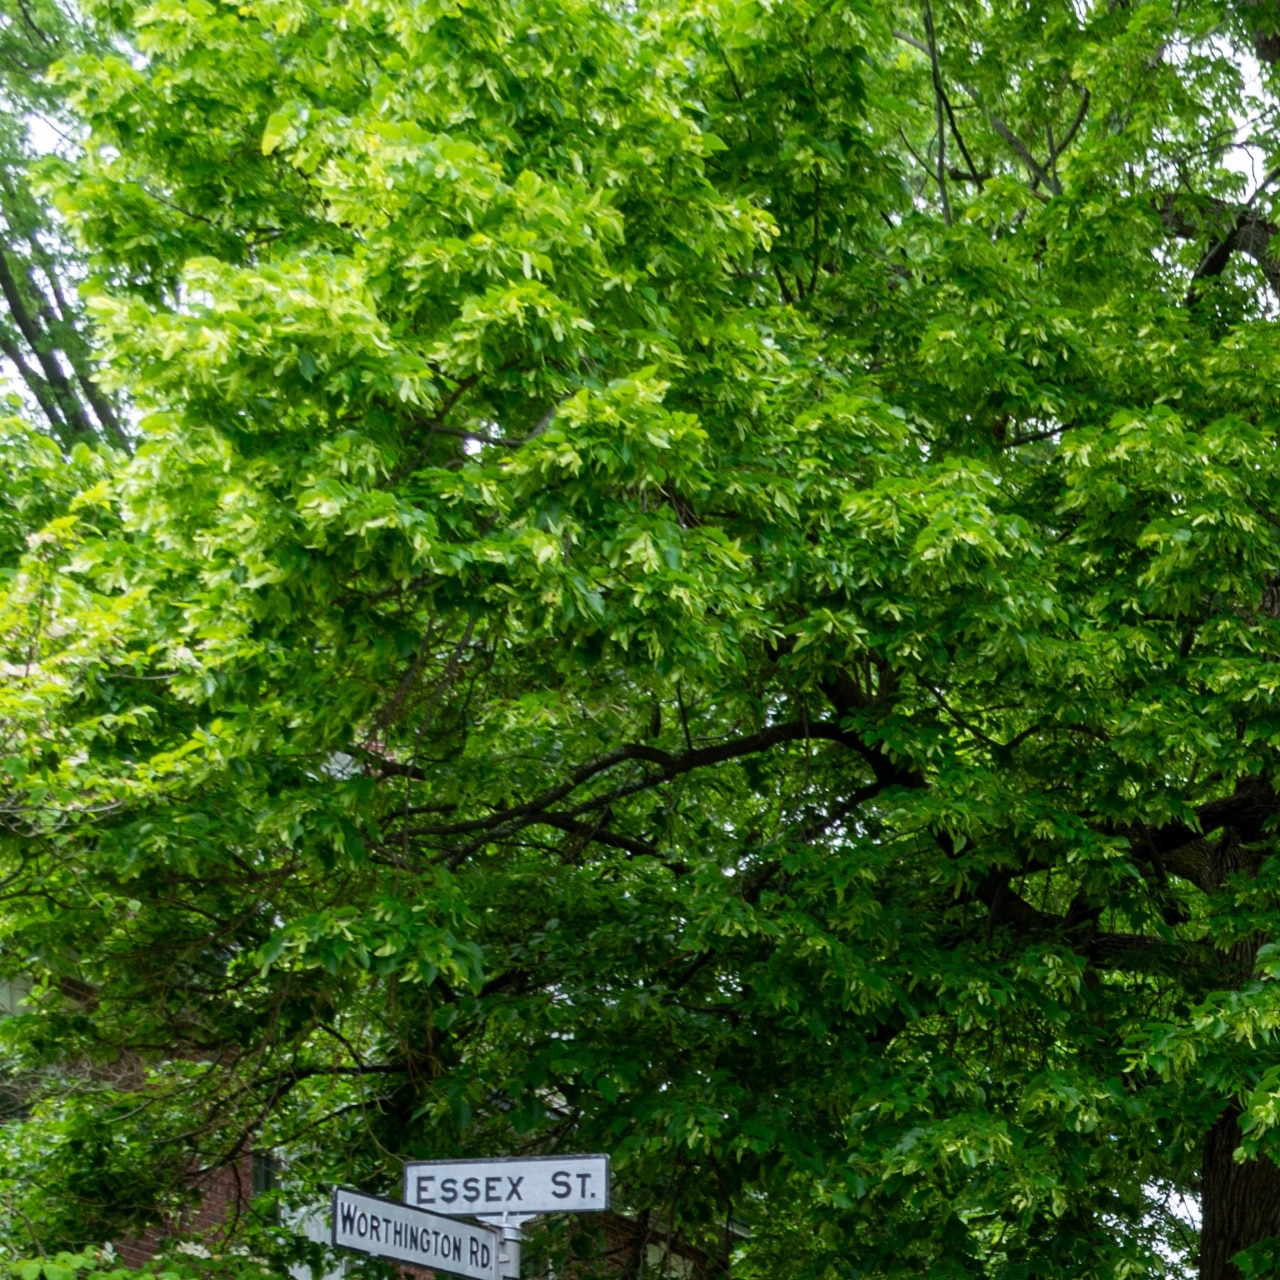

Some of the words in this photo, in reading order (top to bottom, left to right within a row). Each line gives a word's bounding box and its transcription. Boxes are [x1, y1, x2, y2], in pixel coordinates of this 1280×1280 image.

[415, 1175, 525, 1205] ESSEX
[551, 1170, 597, 1199] ST.
[340, 1201, 463, 1263] WORTHINGTON
[469, 1236, 493, 1271] RD.
